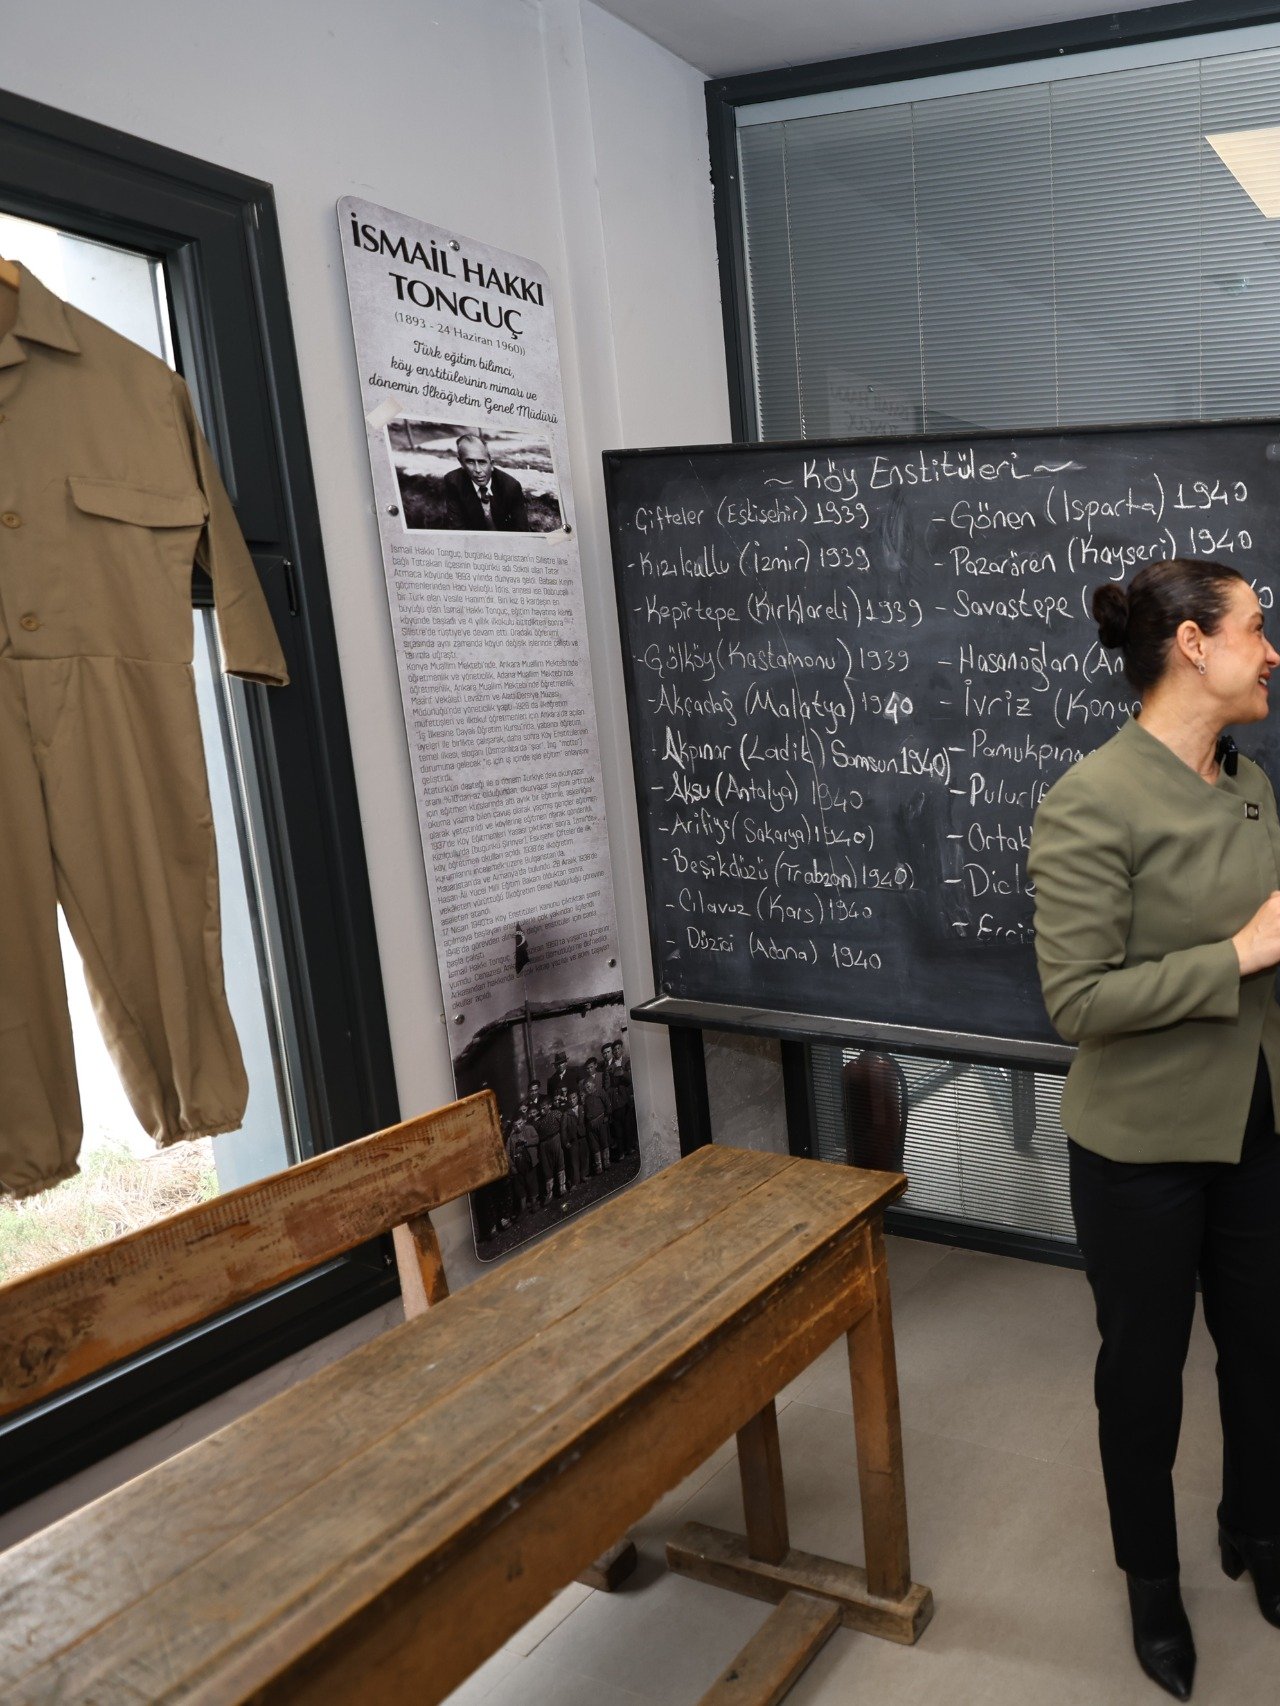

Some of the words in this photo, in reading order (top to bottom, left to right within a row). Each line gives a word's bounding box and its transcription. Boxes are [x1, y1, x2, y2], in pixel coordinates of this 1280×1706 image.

[350, 212, 456, 279] İSMAİL
[462, 257, 545, 307] HAKKI
[388, 272, 524, 340] TONGUÇ
[413, 340, 442, 359] Türk
[444, 351, 478, 368] eğitim
[437, 323, 450, 335] 24
[453, 327, 493, 346] Haziran
[368, 373, 419, 395] dönemin
[422, 381, 481, 408] İlköğretim
[484, 397, 515, 414] Genel
[516, 405, 559, 424] Müdürü
[390, 355, 414, 377] köy
[416, 364, 487, 390] enstitülerinin
[490, 382, 524, 398] mimarı
[526, 391, 538, 401] ve
[803, 459, 858, 500] Köy
[870, 448, 1031, 490] Enstitüleri
[636, 507, 704, 534] Çifteler
[813, 501, 870, 529] 1939
[950, 499, 1036, 539] Gönen
[1046, 472, 1165, 532] (Isparta)
[1173, 480, 1248, 509] 1940
[739, 539, 810, 576] (İzmir)
[820, 545, 871, 573] 1939
[950, 546, 1056, 577] Pazarören
[1190, 526, 1252, 555] 1940
[645, 594, 740, 631] Kepirtepe
[747, 586, 862, 629] (Kırklareli)
[865, 598, 923, 628] 1939
[953, 588, 1075, 626] Savaştepe
[643, 643, 716, 682] Gölköy
[859, 647, 910, 671] 1939
[959, 641, 1079, 692] Hasanoğlan
[654, 683, 738, 727] Akçadağ
[744, 680, 855, 735] (Malatya)
[861, 691, 914, 724] 1940
[964, 678, 1032, 718] İvriz
[661, 726, 732, 773] Akpınar
[739, 728, 825, 770] (Ladik)
[665, 771, 711, 807] Aksu
[715, 770, 799, 812] (Antalya)
[811, 781, 863, 812] 1940
[671, 808, 731, 846] Arifiye
[756, 886, 824, 924] (Kars)
[828, 897, 873, 921] 1940
[749, 931, 818, 964] (Adana)
[832, 942, 882, 970] 1940
